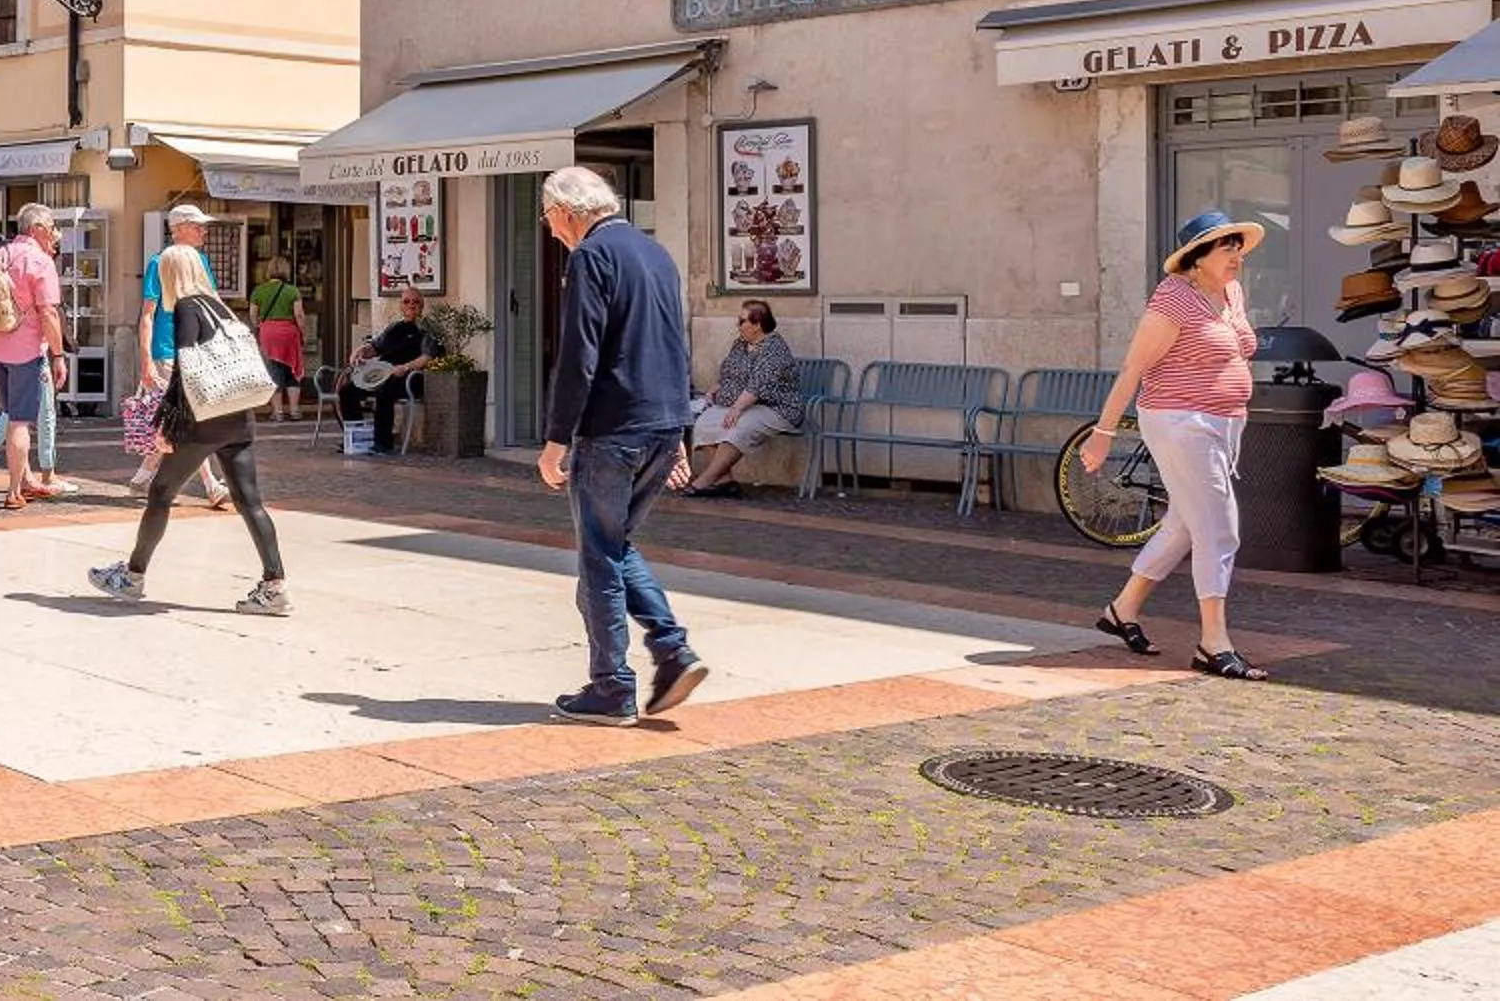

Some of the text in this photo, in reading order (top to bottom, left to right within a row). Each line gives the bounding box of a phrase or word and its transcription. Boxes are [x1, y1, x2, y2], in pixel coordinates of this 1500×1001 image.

[1083, 21, 1374, 75] GELATI & PIZZA
[365, 158, 385, 177] del
[393, 151, 469, 176] GELATO
[478, 150, 500, 170] dal
[504, 150, 541, 168] 1985
